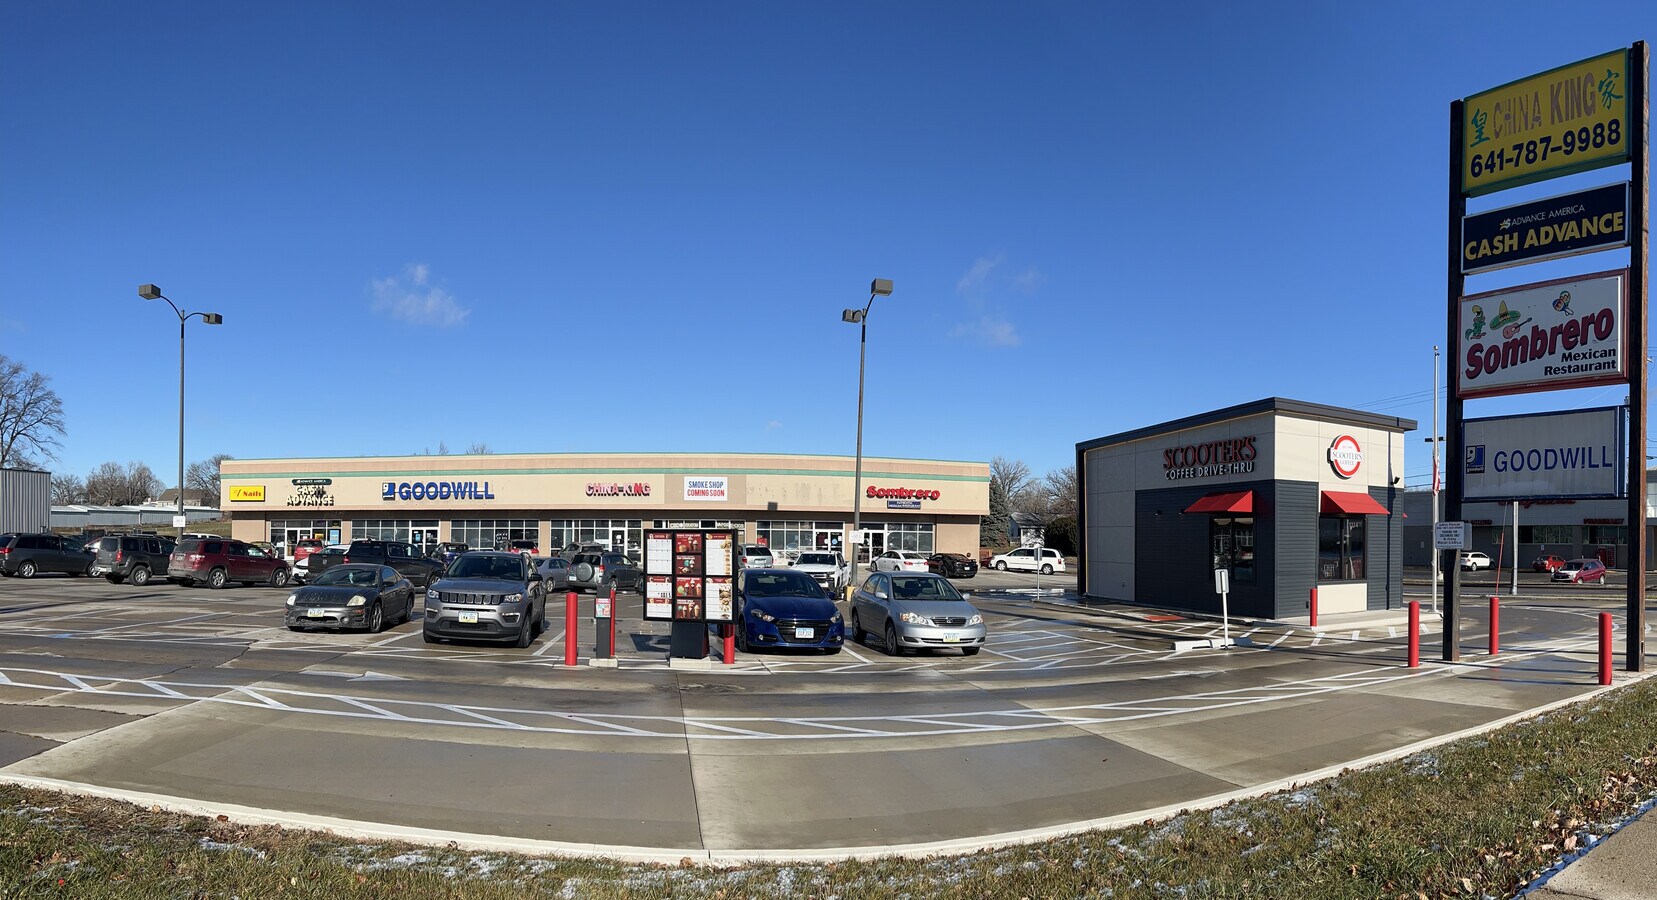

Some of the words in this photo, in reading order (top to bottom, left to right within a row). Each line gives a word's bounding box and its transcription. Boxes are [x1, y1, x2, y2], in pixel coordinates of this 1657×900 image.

[1598, 69, 1623, 109] 家
[1493, 91, 1542, 139] CHINA
[1550, 72, 1596, 125] KING
[1470, 108, 1490, 147] 皇
[1470, 119, 1621, 178] 641-787-9988
[1511, 211, 1546, 226] ADVANCE
[1548, 204, 1585, 218] AMERICA
[1465, 232, 1519, 261] CASH
[1523, 211, 1624, 249] ADVANCE
[1465, 307, 1614, 380] Sombrero
[1561, 348, 1616, 363] Mexican
[1544, 359, 1616, 376] Restaurant
[1162, 435, 1257, 469] SCOOTER'S
[1332, 451, 1363, 461] SCOOTER'S
[1493, 446, 1613, 472] GOODWILL
[1165, 467, 1195, 480] COFFEE
[1198, 461, 1253, 477] DRIVE-THRU
[398, 482, 495, 500] GOODWILL
[622, 483, 651, 496] KING
[687, 489, 709, 497] COMING
[710, 489, 725, 497] SOON
[688, 481, 708, 489] SMOKE
[709, 481, 724, 489] SHOP
[866, 485, 941, 500] Sombrero
[286, 495, 335, 506] ADVANCE
